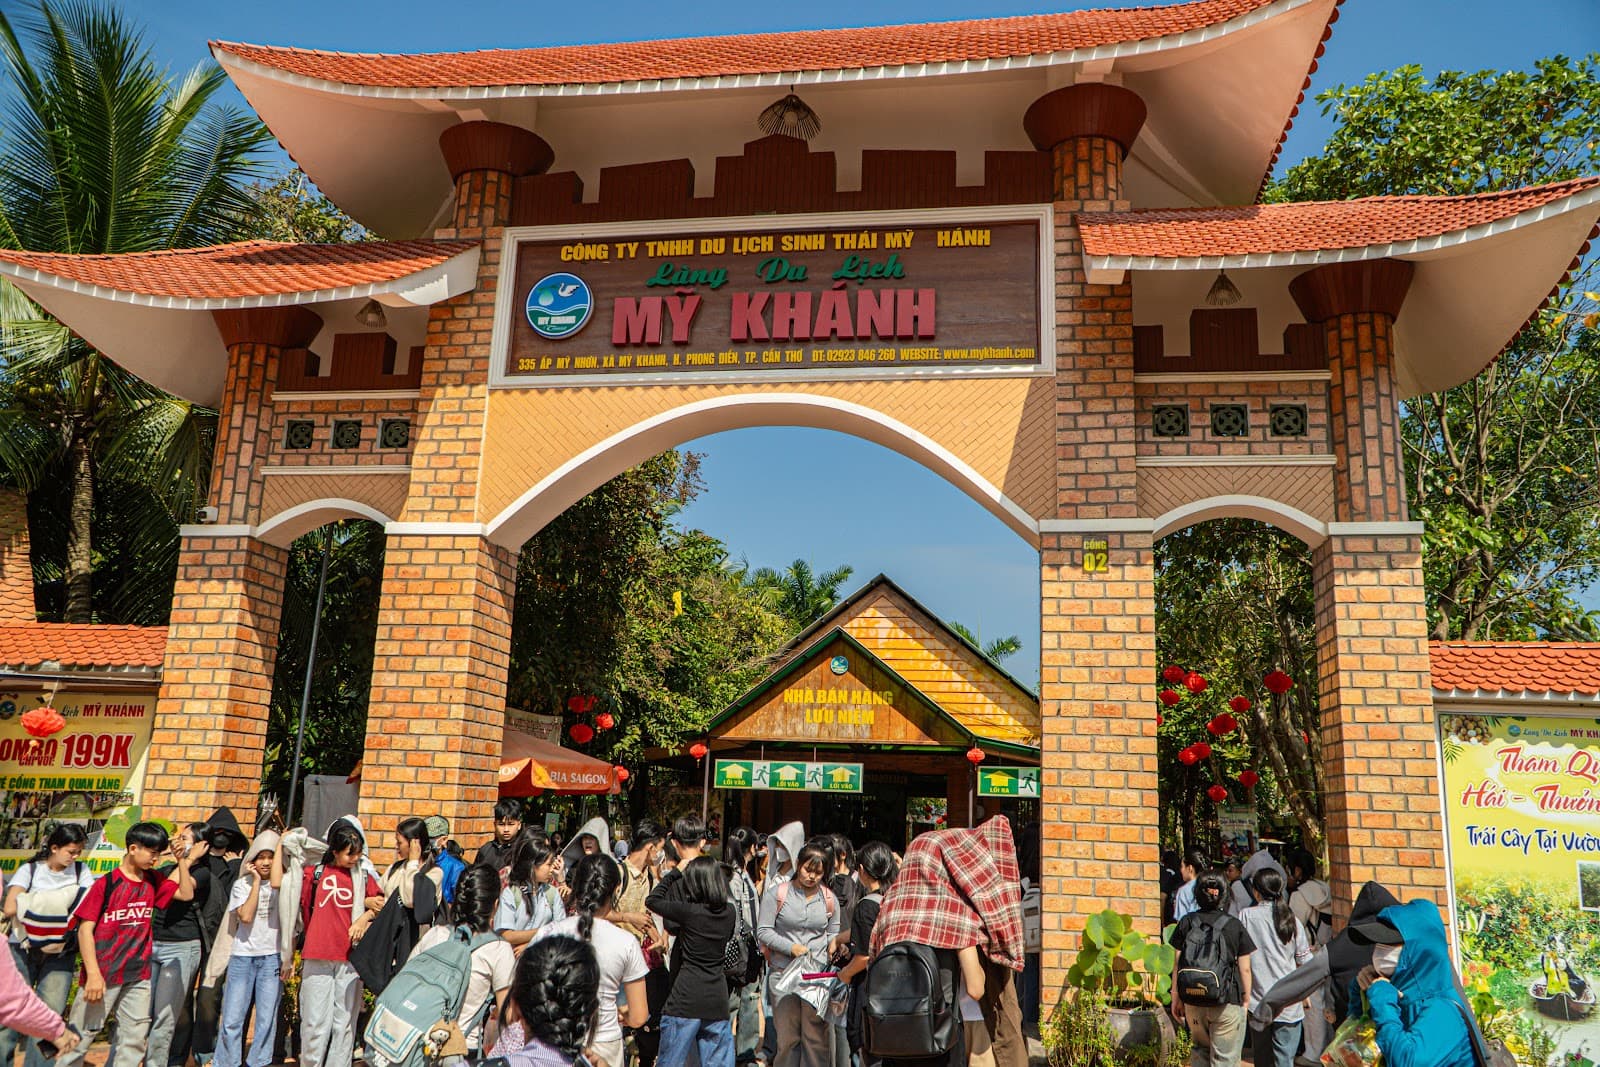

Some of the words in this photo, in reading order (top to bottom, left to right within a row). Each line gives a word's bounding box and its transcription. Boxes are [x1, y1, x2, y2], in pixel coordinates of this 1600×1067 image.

[560, 242, 609, 261] CÔNG
[615, 242, 640, 259] TY
[645, 239, 695, 258] TNHH
[700, 238, 726, 255] DU
[732, 235, 774, 256] LỊCH
[781, 233, 826, 252] SINH
[832, 230, 878, 250] THÁI
[884, 228, 915, 249] MỸ
[646, 261, 729, 289] Làng
[756, 257, 809, 283] Du
[832, 254, 905, 285] Lịch
[612, 287, 702, 346] MỸ
[730, 281, 936, 342] KHÁNH
[518, 358, 536, 371] 335
[672, 353, 683, 366] H.
[686, 352, 715, 365] PHONG
[745, 351, 759, 364] TP.
[785, 348, 804, 362] THƠ
[827, 349, 855, 362] 02923
[857, 349, 876, 362] 846
[878, 347, 896, 361] 260
[900, 348, 942, 361] WEBSITE:
[943, 346, 1035, 361] www.mykhanh.com
[1083, 552, 1107, 571] 02
[783, 686, 814, 704] NHÀ
[817, 686, 848, 704] BÁN
[851, 687, 894, 705] HÀNG
[83, 702, 101, 717] MỸ
[104, 702, 145, 717] KHÁNH
[805, 708, 834, 724] LƯU
[838, 708, 875, 728] NIỆM
[1586, 729, 1600, 738] KH
[0, 738, 58, 761] OMBO
[62, 733, 134, 767] 199K
[1497, 747, 1560, 772] Tham
[40, 777, 67, 789] THAM
[69, 777, 94, 790] QUAN
[96, 775, 120, 790] LÀNG
[570, 772, 607, 785] SAIGON
[1462, 780, 1506, 807] Hái
[1466, 825, 1496, 847] Trái
[1501, 828, 1532, 855] Cây
[1535, 829, 1557, 853] Tại
